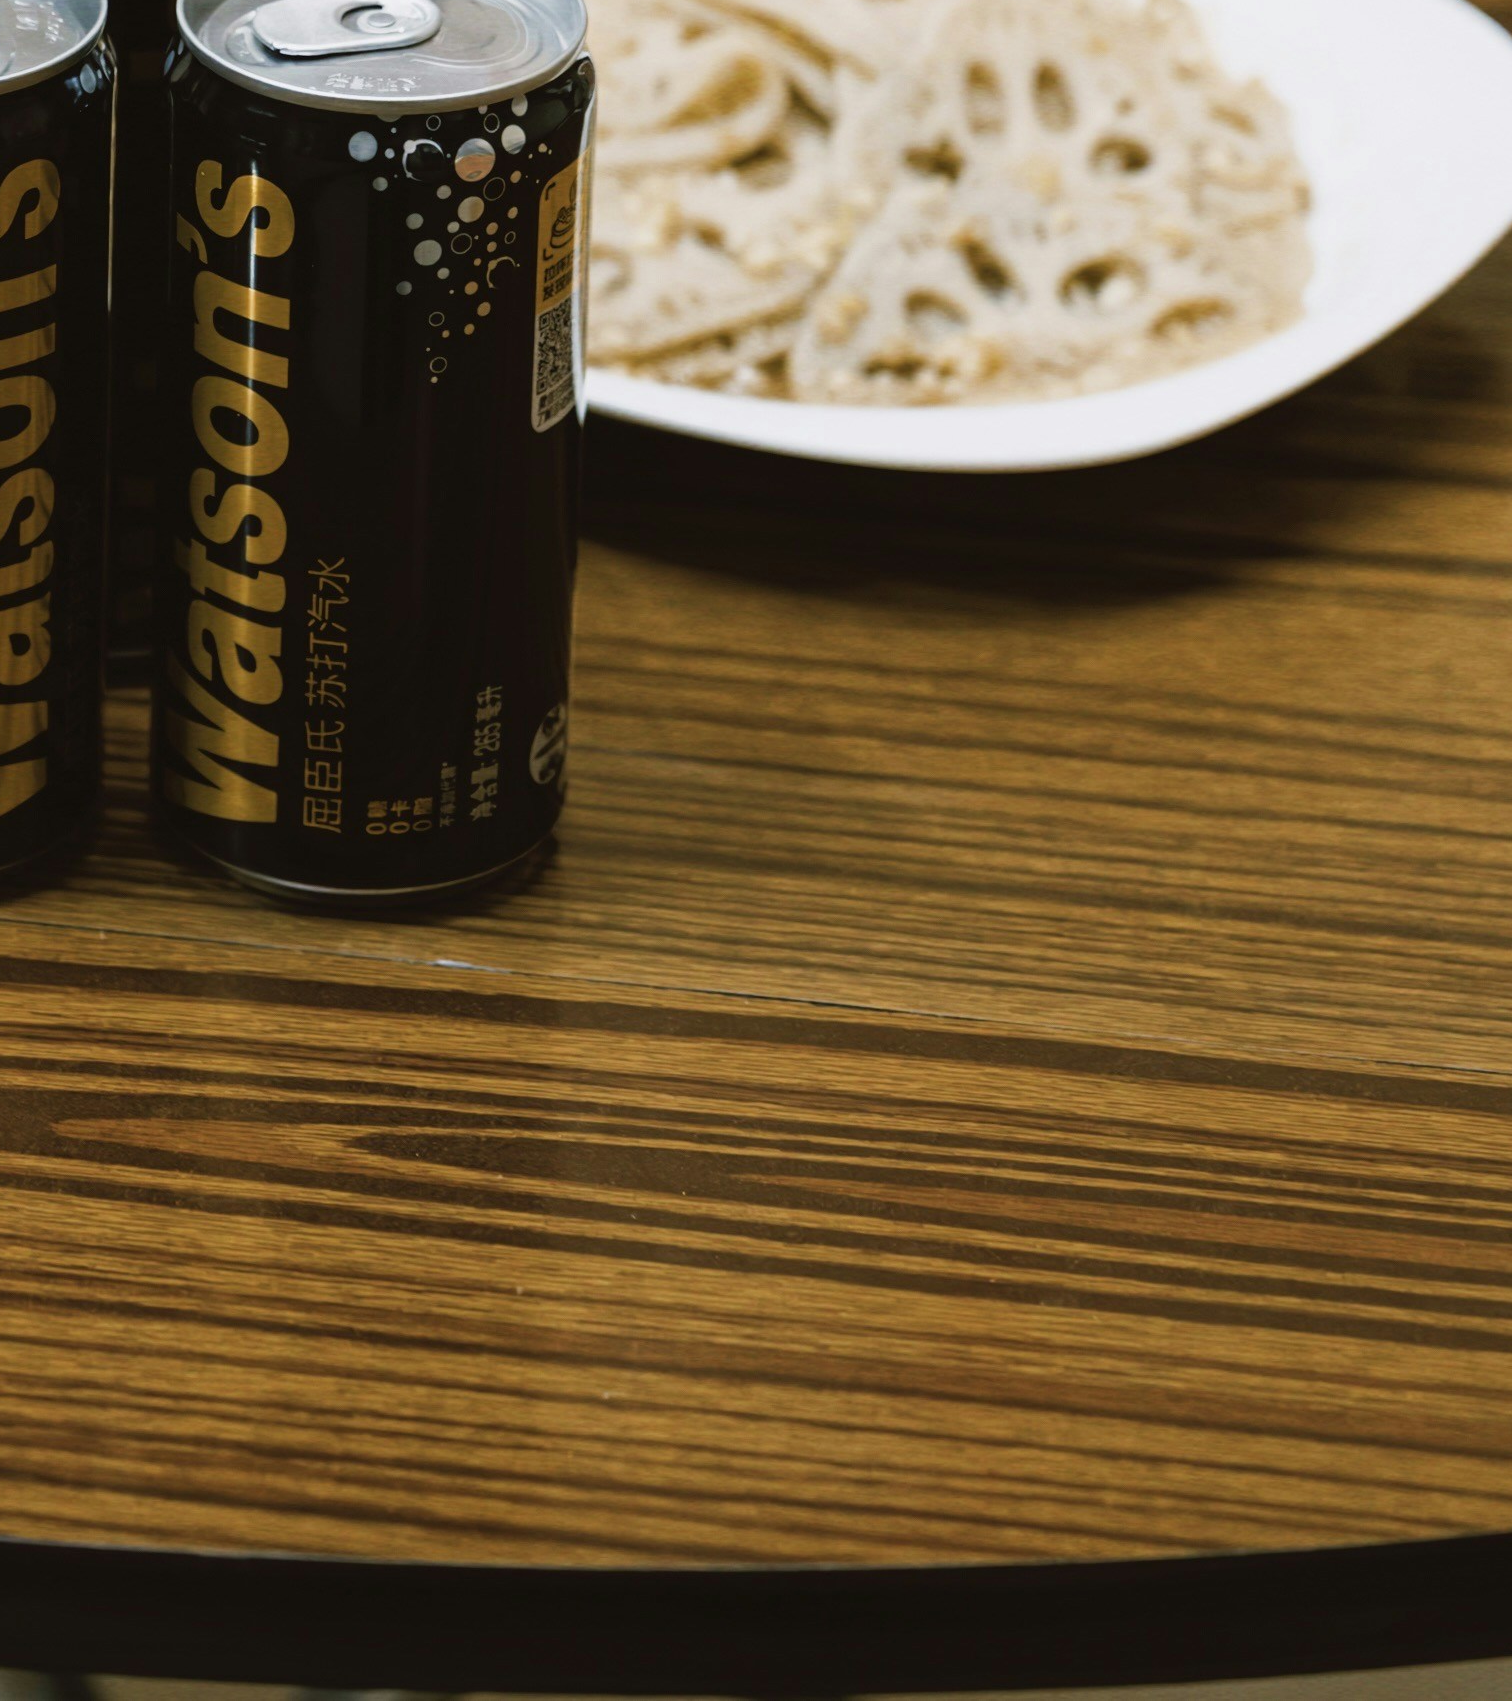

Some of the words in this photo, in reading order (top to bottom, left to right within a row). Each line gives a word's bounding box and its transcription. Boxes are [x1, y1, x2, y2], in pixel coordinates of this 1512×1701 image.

[165, 160, 296, 827] Watson's
[303, 556, 350, 710] 苏打汽水
[302, 719, 346, 834] 屈臣氏
